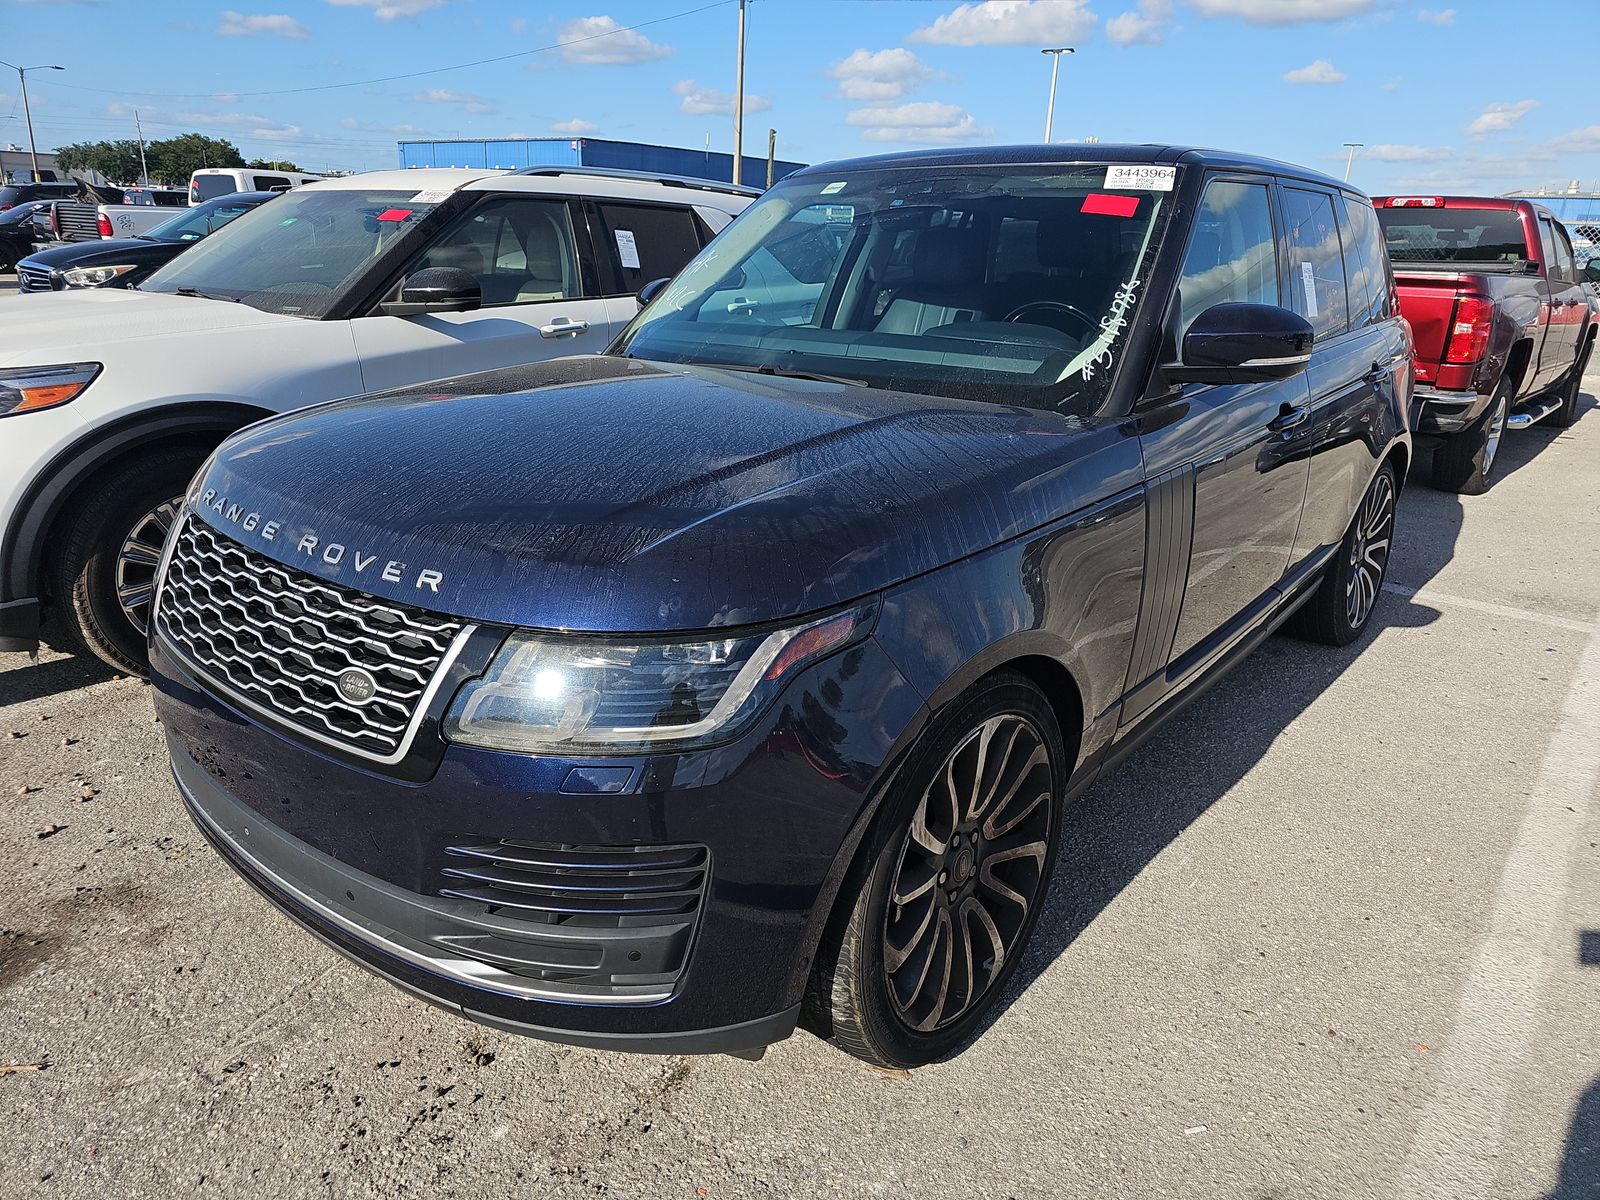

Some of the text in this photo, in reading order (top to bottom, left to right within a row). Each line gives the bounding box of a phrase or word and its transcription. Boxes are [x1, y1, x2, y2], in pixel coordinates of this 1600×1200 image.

[1115, 168, 1175, 179] 3443964
[202, 488, 443, 592] RANGE ROVER
[345, 674, 365, 687] LAND
[344, 683, 369, 697] ROVER
